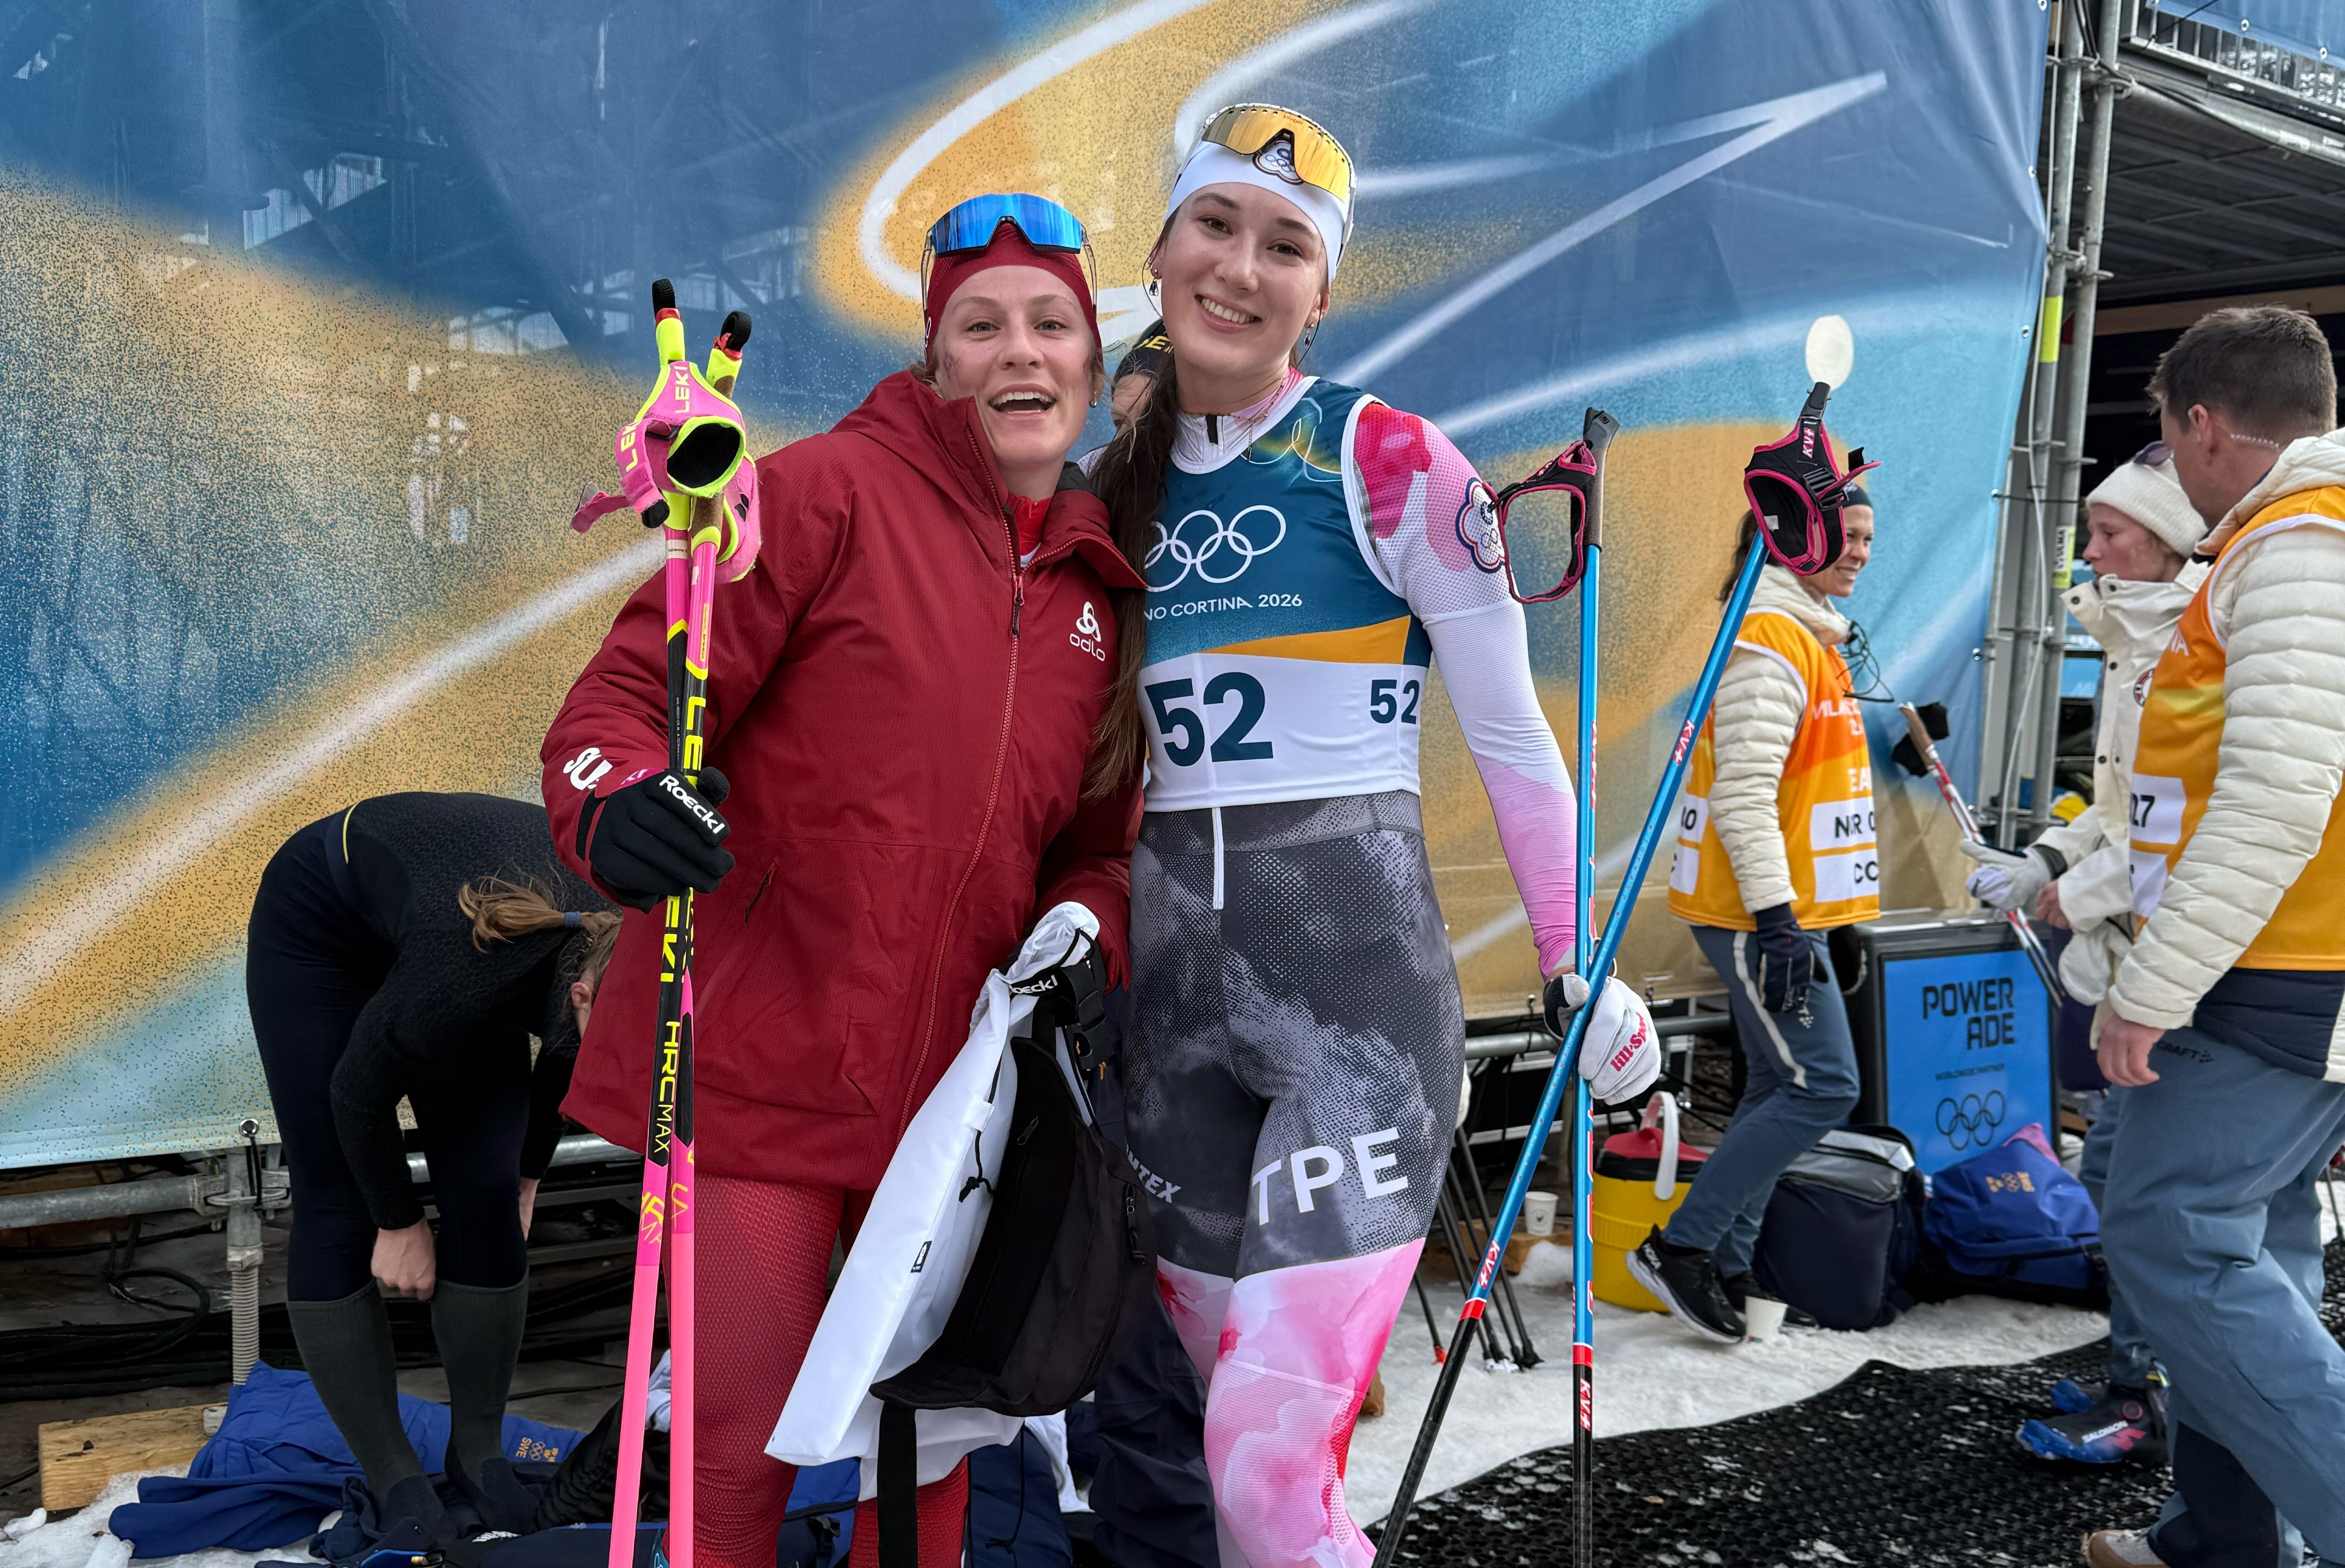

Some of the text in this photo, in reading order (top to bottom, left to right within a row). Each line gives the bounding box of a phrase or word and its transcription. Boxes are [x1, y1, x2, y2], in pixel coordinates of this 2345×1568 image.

[675, 366, 690, 413] LEKI
[621, 420, 642, 472] LEK
[1171, 596, 1253, 617] CORTINA
[1258, 594, 1303, 607] 2026
[1069, 632, 1106, 662] odlo
[1144, 672, 1274, 767] 52
[1370, 679, 1419, 726] 52
[1673, 719, 1695, 765] KV+
[1835, 813, 1863, 838] NR
[1922, 977, 2015, 1020] POWER
[1967, 1012, 2016, 1050] ADE
[1127, 1144, 1182, 1204] NTEX
[1252, 1126, 1409, 1226] TPE
[1480, 1240, 1500, 1287] KV+
[1580, 1378, 1591, 1430] KV+
[516, 1437, 532, 1459] SWE
